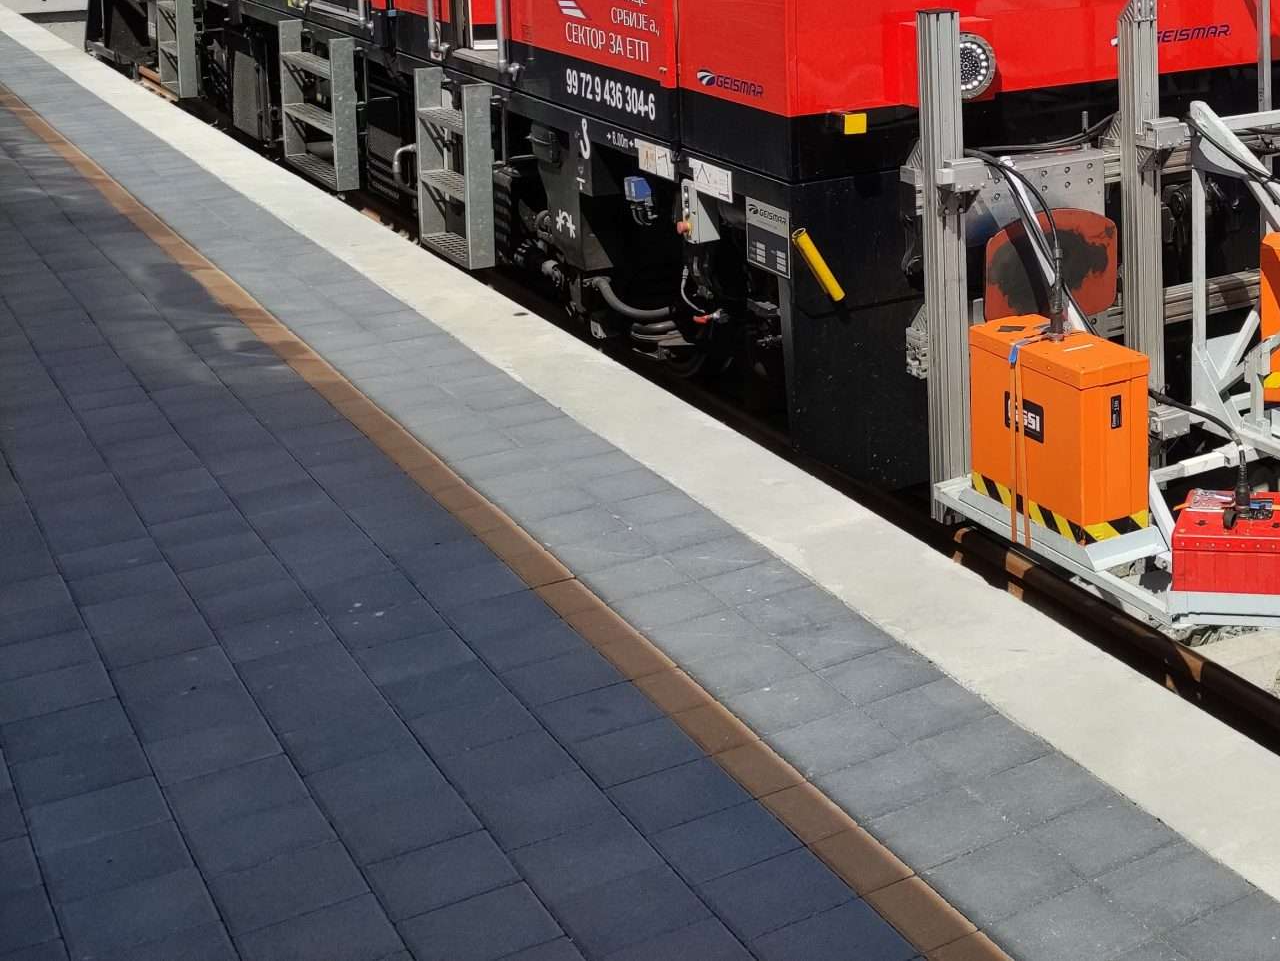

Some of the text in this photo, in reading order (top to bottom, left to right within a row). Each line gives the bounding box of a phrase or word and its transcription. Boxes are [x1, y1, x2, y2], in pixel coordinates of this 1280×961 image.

[610, 6, 649, 31] СРБИЈЕ
[565, 22, 649, 62] СЕКТОР ЗА ЕТП
[566, 68, 656, 121] 99 72 9 436 304-6
[716, 75, 764, 96] GEISMAR
[759, 208, 787, 225] GEISMAR
